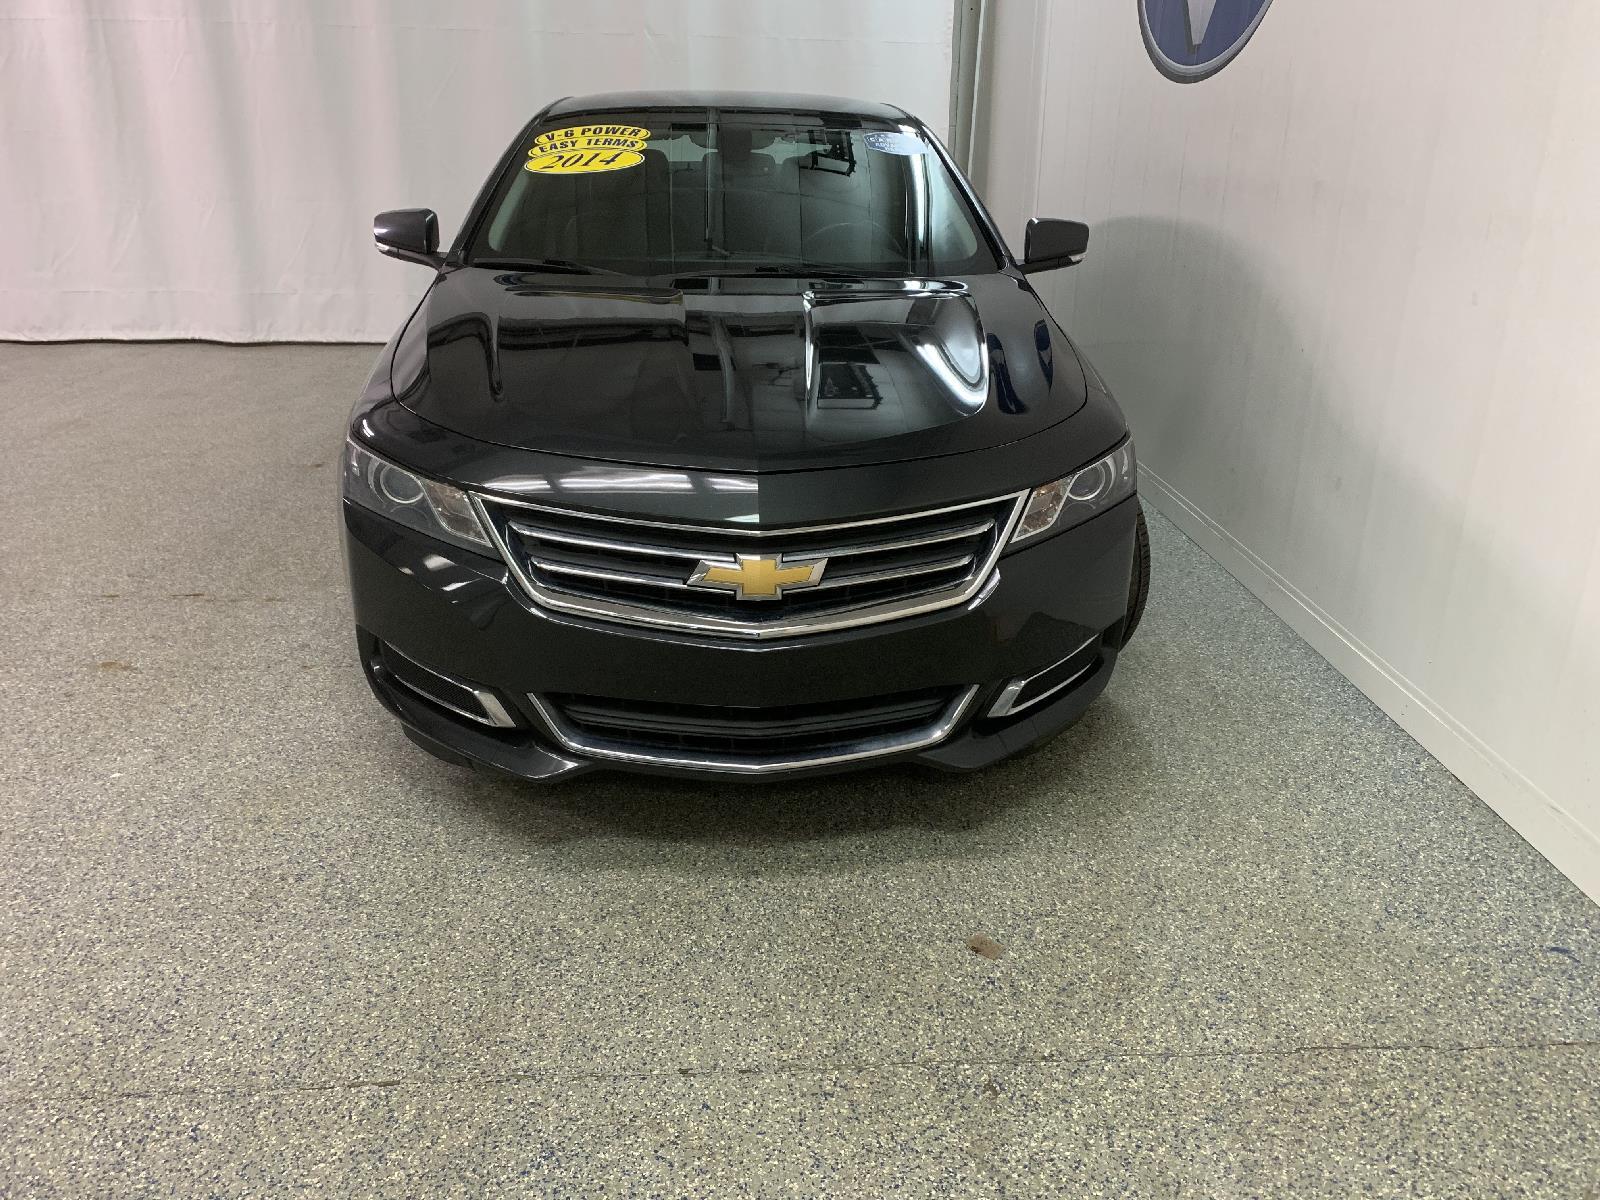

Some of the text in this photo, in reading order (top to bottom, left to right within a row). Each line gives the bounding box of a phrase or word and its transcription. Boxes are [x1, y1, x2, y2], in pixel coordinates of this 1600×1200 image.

[545, 126, 642, 141] V-6 POWER
[538, 138, 639, 152] EASY TERMS
[540, 151, 624, 169] 2014
